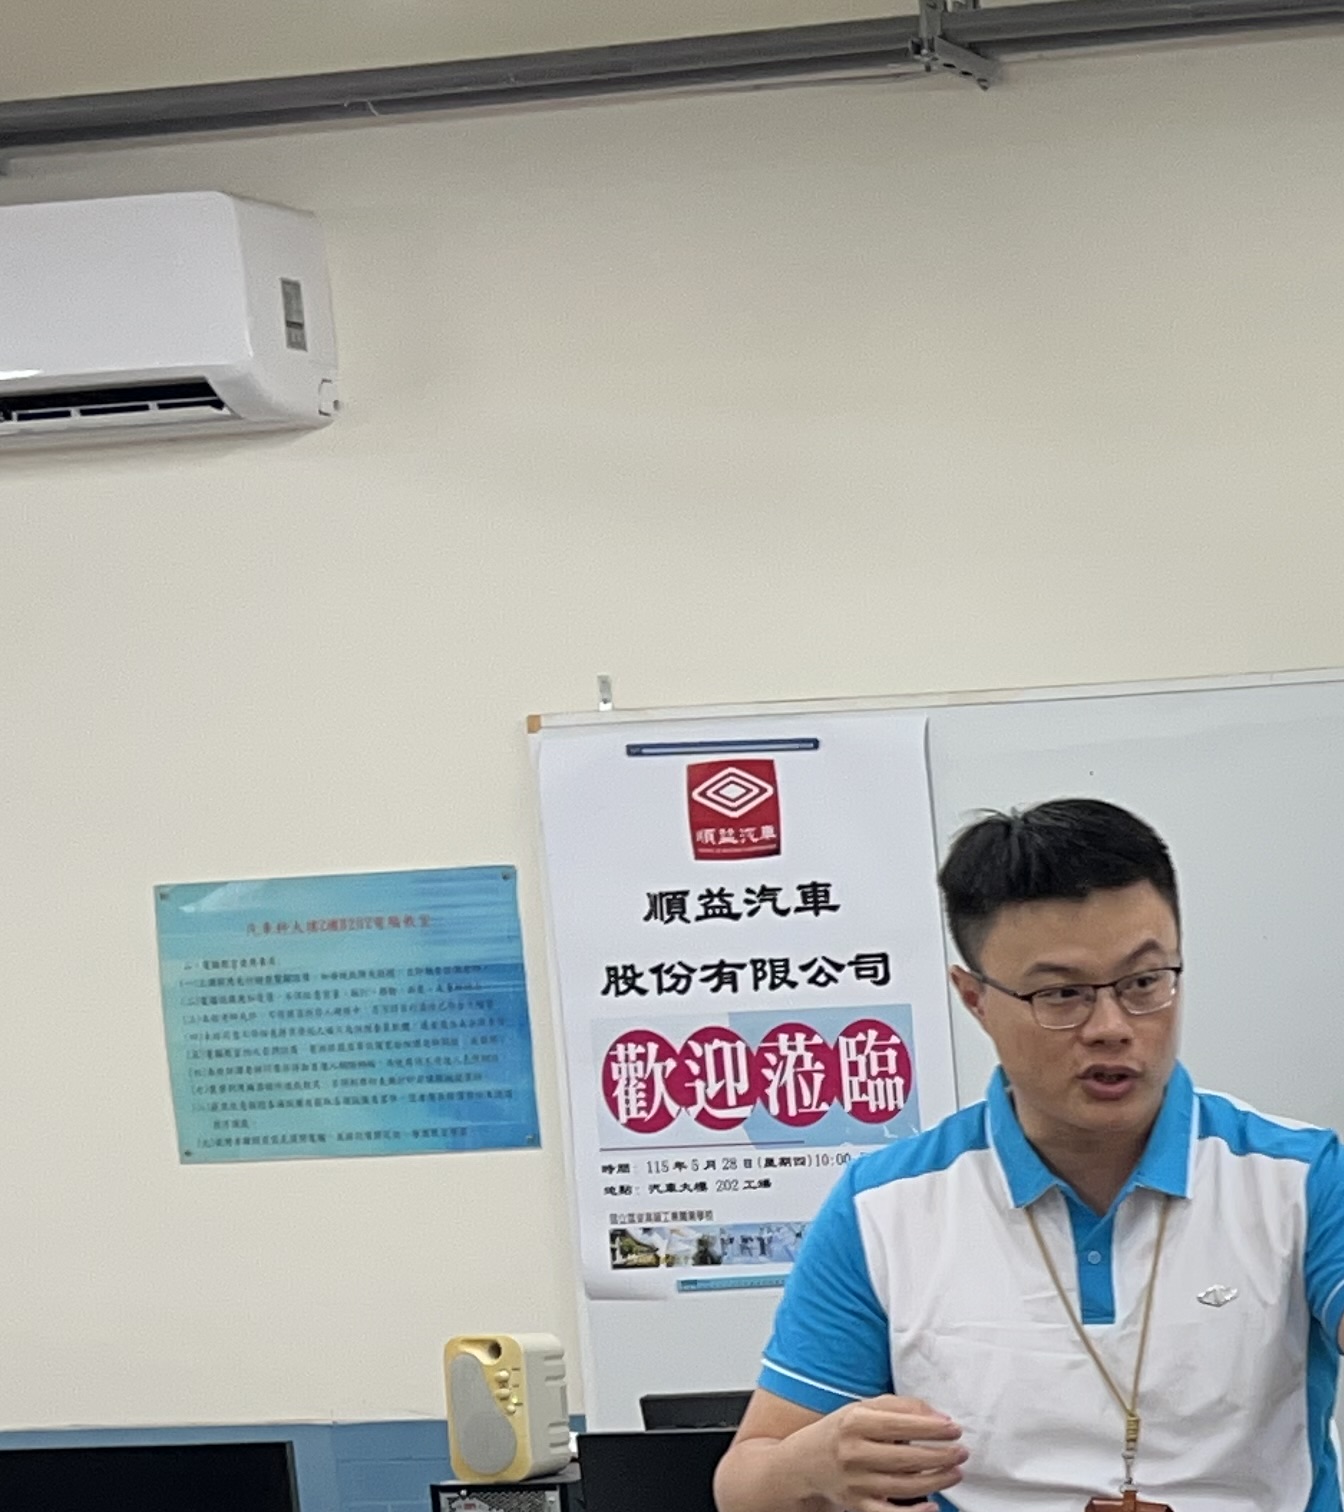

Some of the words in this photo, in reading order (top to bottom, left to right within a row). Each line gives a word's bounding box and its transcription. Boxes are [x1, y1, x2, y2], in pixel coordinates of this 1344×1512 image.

[695, 826, 778, 847] 順益汽車
[642, 881, 841, 924] 順益汽車
[601, 952, 892, 998] 股份有限公司
[608, 1029, 906, 1127] 歡迎蒞臨
